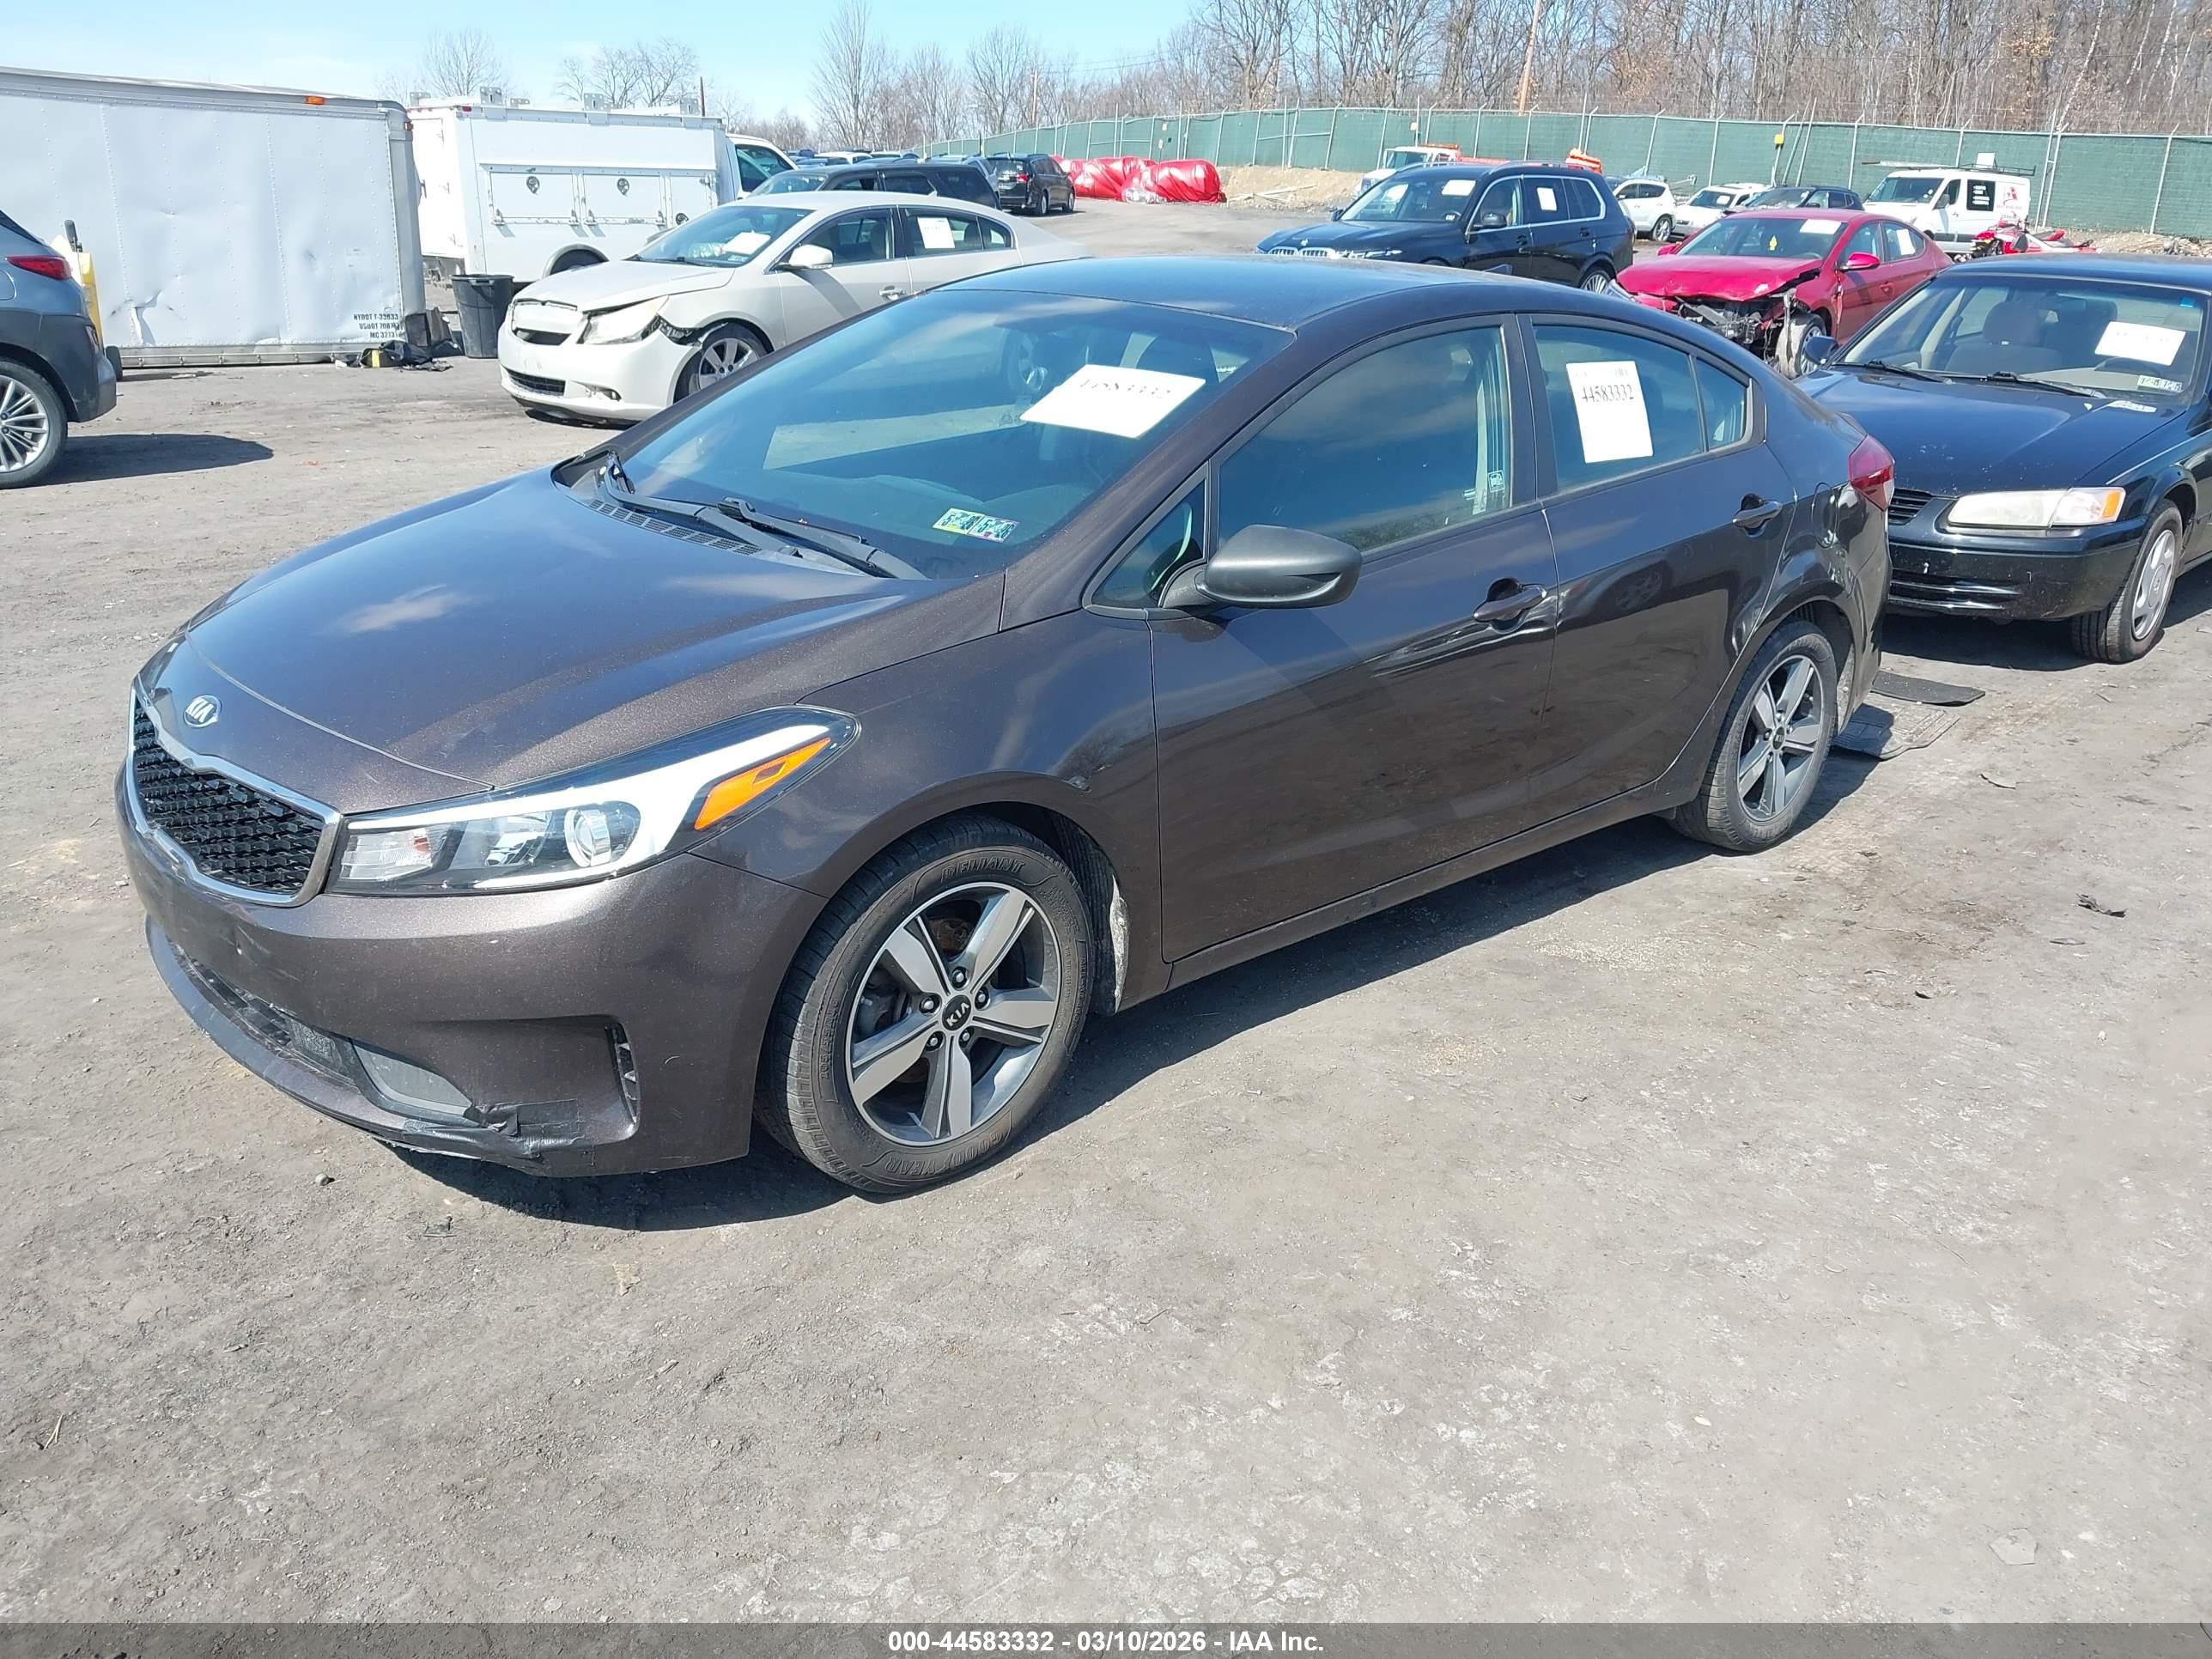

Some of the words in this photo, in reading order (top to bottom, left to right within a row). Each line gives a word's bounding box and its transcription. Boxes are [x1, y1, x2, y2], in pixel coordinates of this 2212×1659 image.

[1582, 384, 1634, 403] 44583332
[185, 696, 215, 723] KIA
[941, 857, 1026, 883] RELIANT
[946, 1002, 969, 1027] KIA
